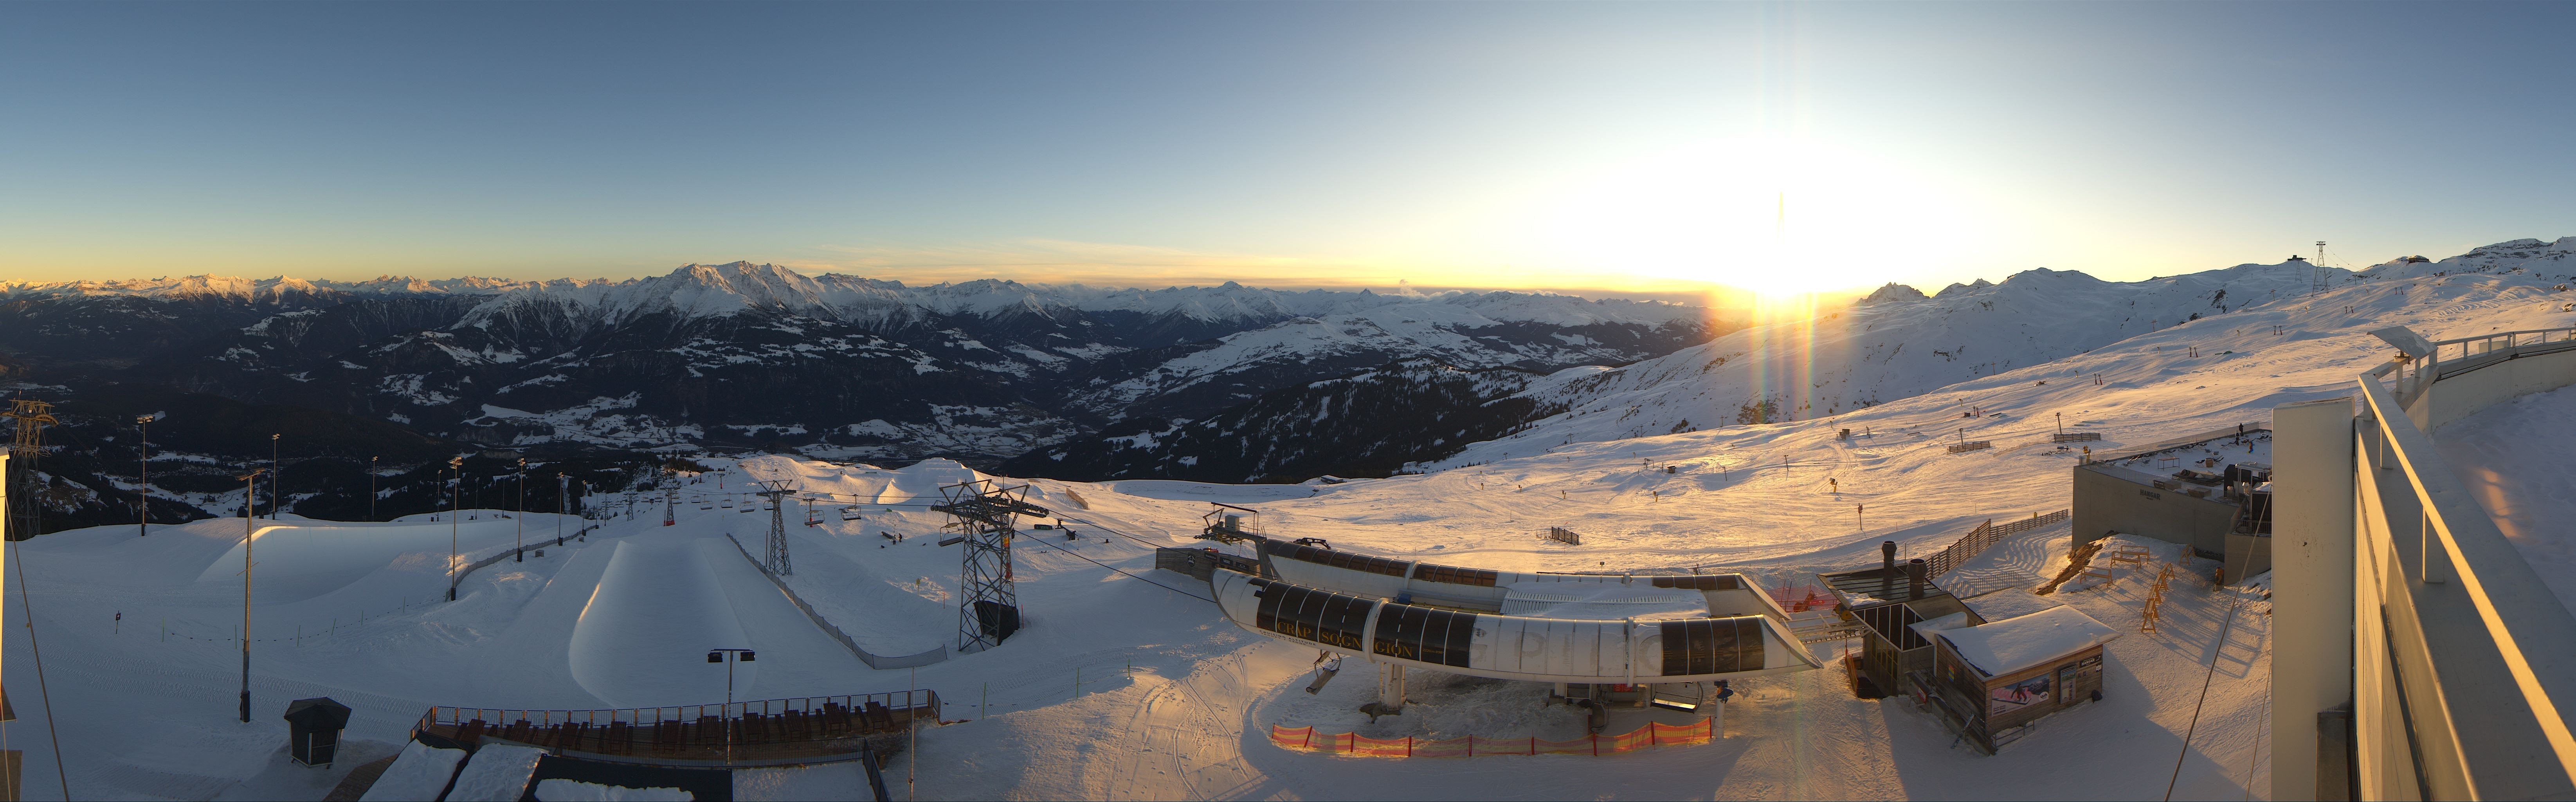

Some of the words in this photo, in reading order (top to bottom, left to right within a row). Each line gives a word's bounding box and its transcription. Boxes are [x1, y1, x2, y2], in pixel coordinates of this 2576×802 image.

[2140, 489, 2160, 500] HANGAR
[1259, 630, 1286, 639] CRUISING
[1288, 637, 1316, 646] ALTITUDE
[1277, 622, 1311, 637] CRAP
[1321, 631, 1362, 648] SOGN
[1375, 641, 1413, 657] GION
